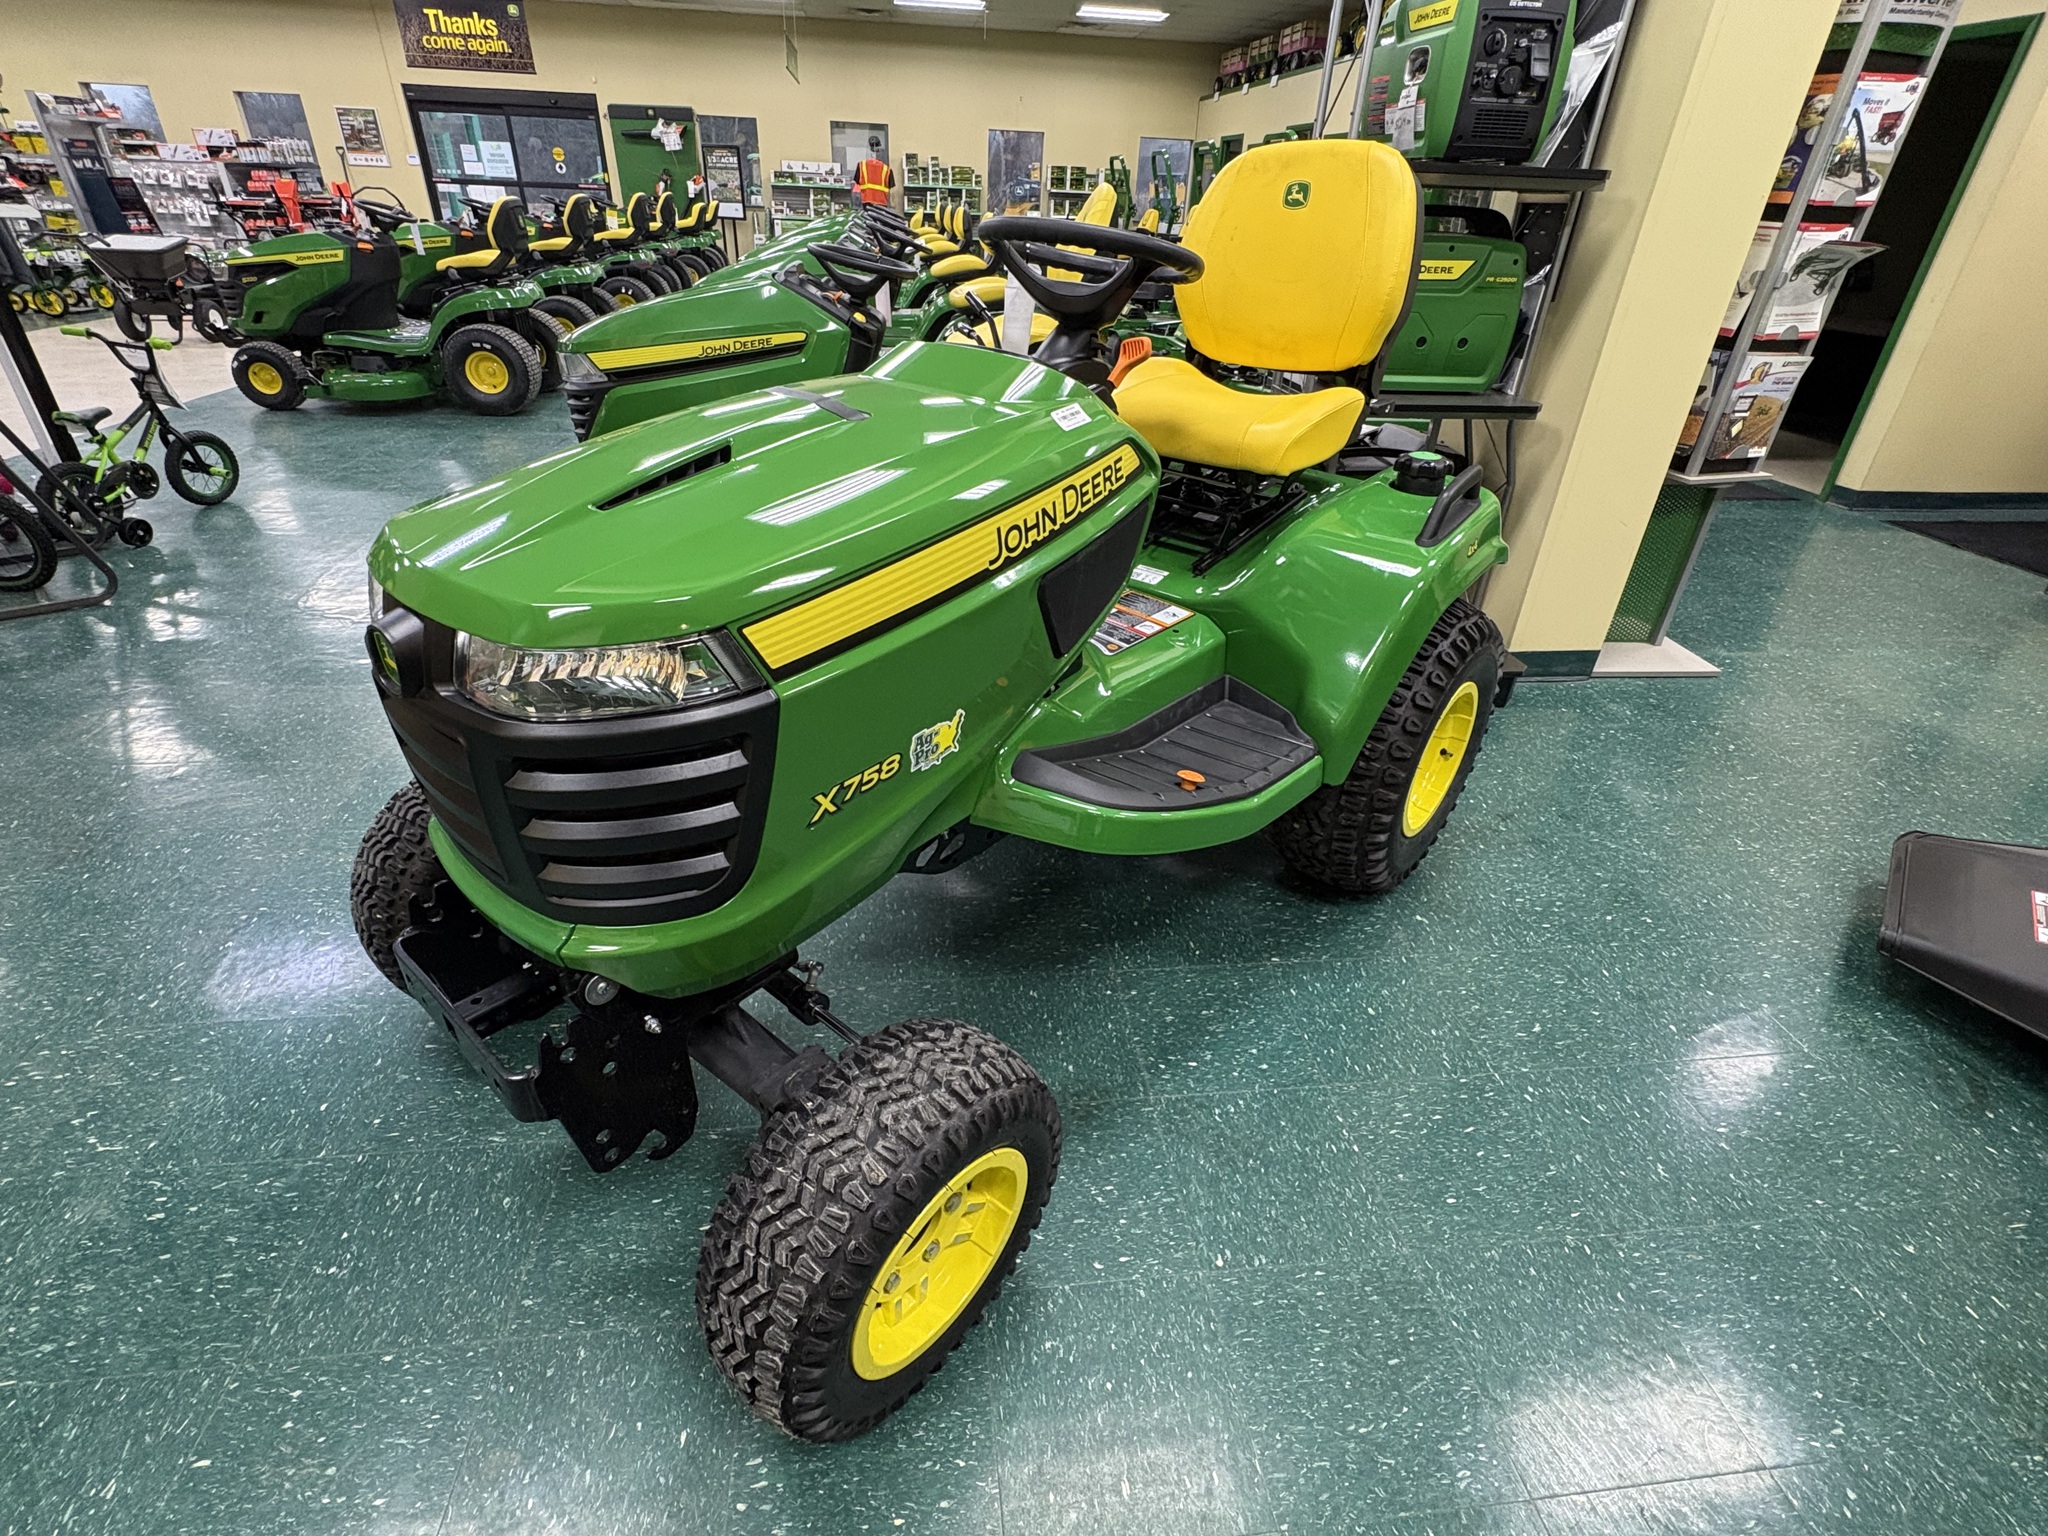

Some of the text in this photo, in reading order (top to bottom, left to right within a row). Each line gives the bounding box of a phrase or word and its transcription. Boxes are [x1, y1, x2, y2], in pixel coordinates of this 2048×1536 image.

[423, 8, 498, 36] Thanks
[1413, 5, 1452, 25] JOHN DEERE
[422, 35, 512, 55] come again.
[295, 252, 339, 262] JOHN DEERE
[1420, 264, 1455, 275] DEERE
[699, 337, 774, 357] JOHN DEERE
[988, 455, 1125, 567] JOHN DEERE
[913, 729, 940, 752] Ag-
[913, 742, 940, 768] Pro
[806, 752, 903, 828] X758
